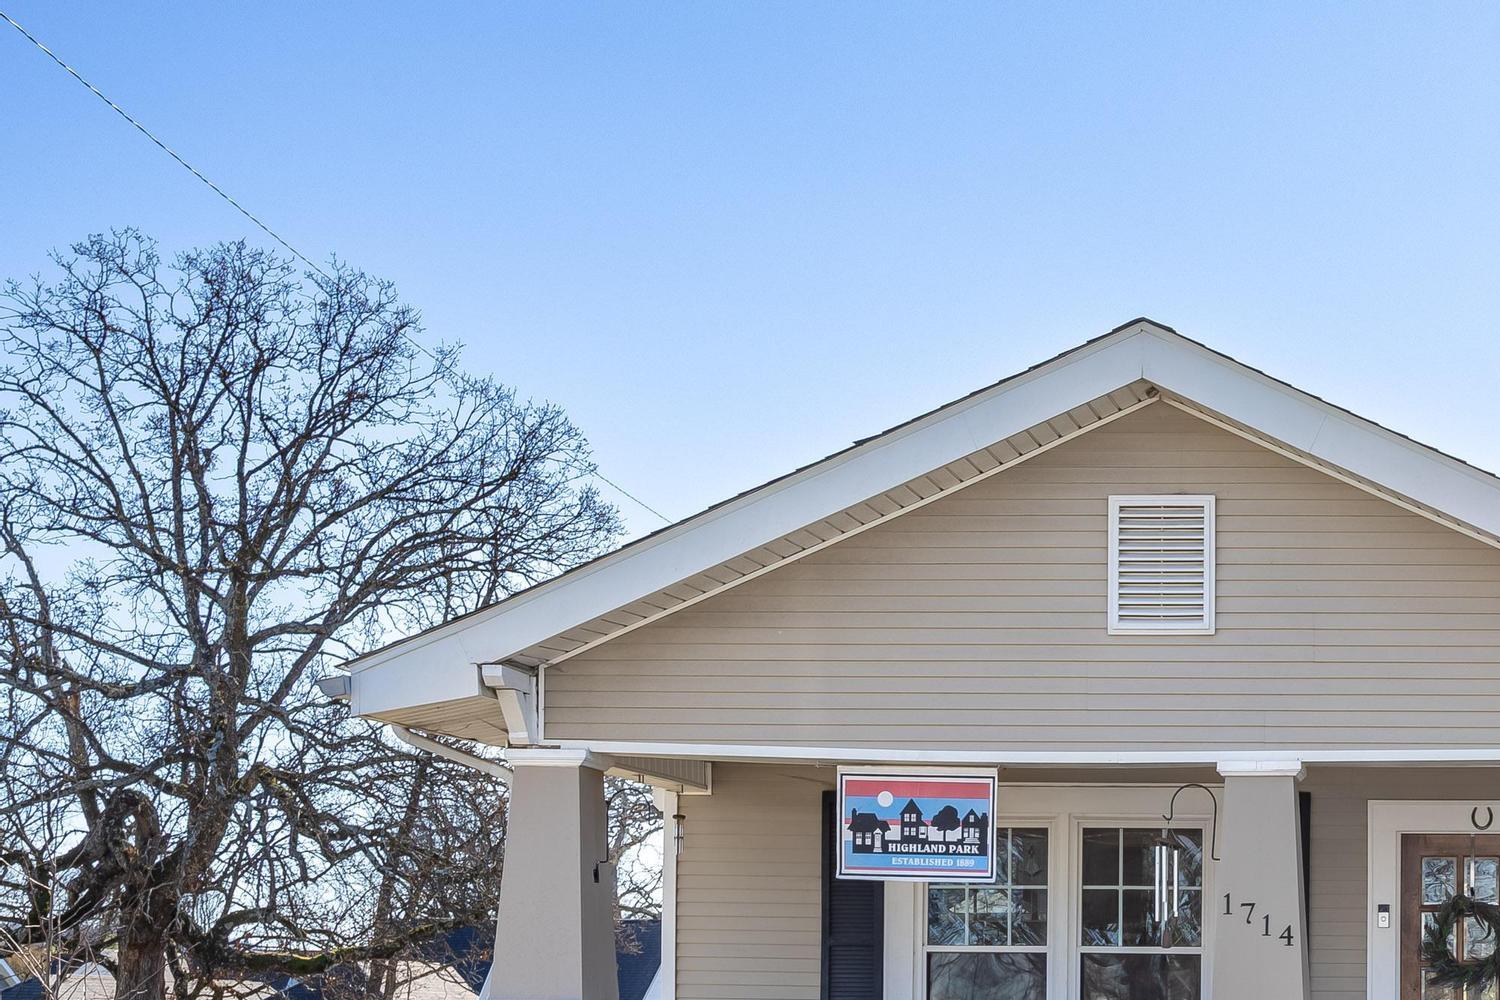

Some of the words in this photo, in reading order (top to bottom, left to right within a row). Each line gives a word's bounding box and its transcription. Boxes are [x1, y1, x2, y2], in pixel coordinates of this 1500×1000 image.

[888, 843, 946, 853] HIGHLAND
[948, 844, 979, 854] PARK
[892, 857, 954, 867] ESTABLISHED
[1222, 892, 1294, 946] 1714
